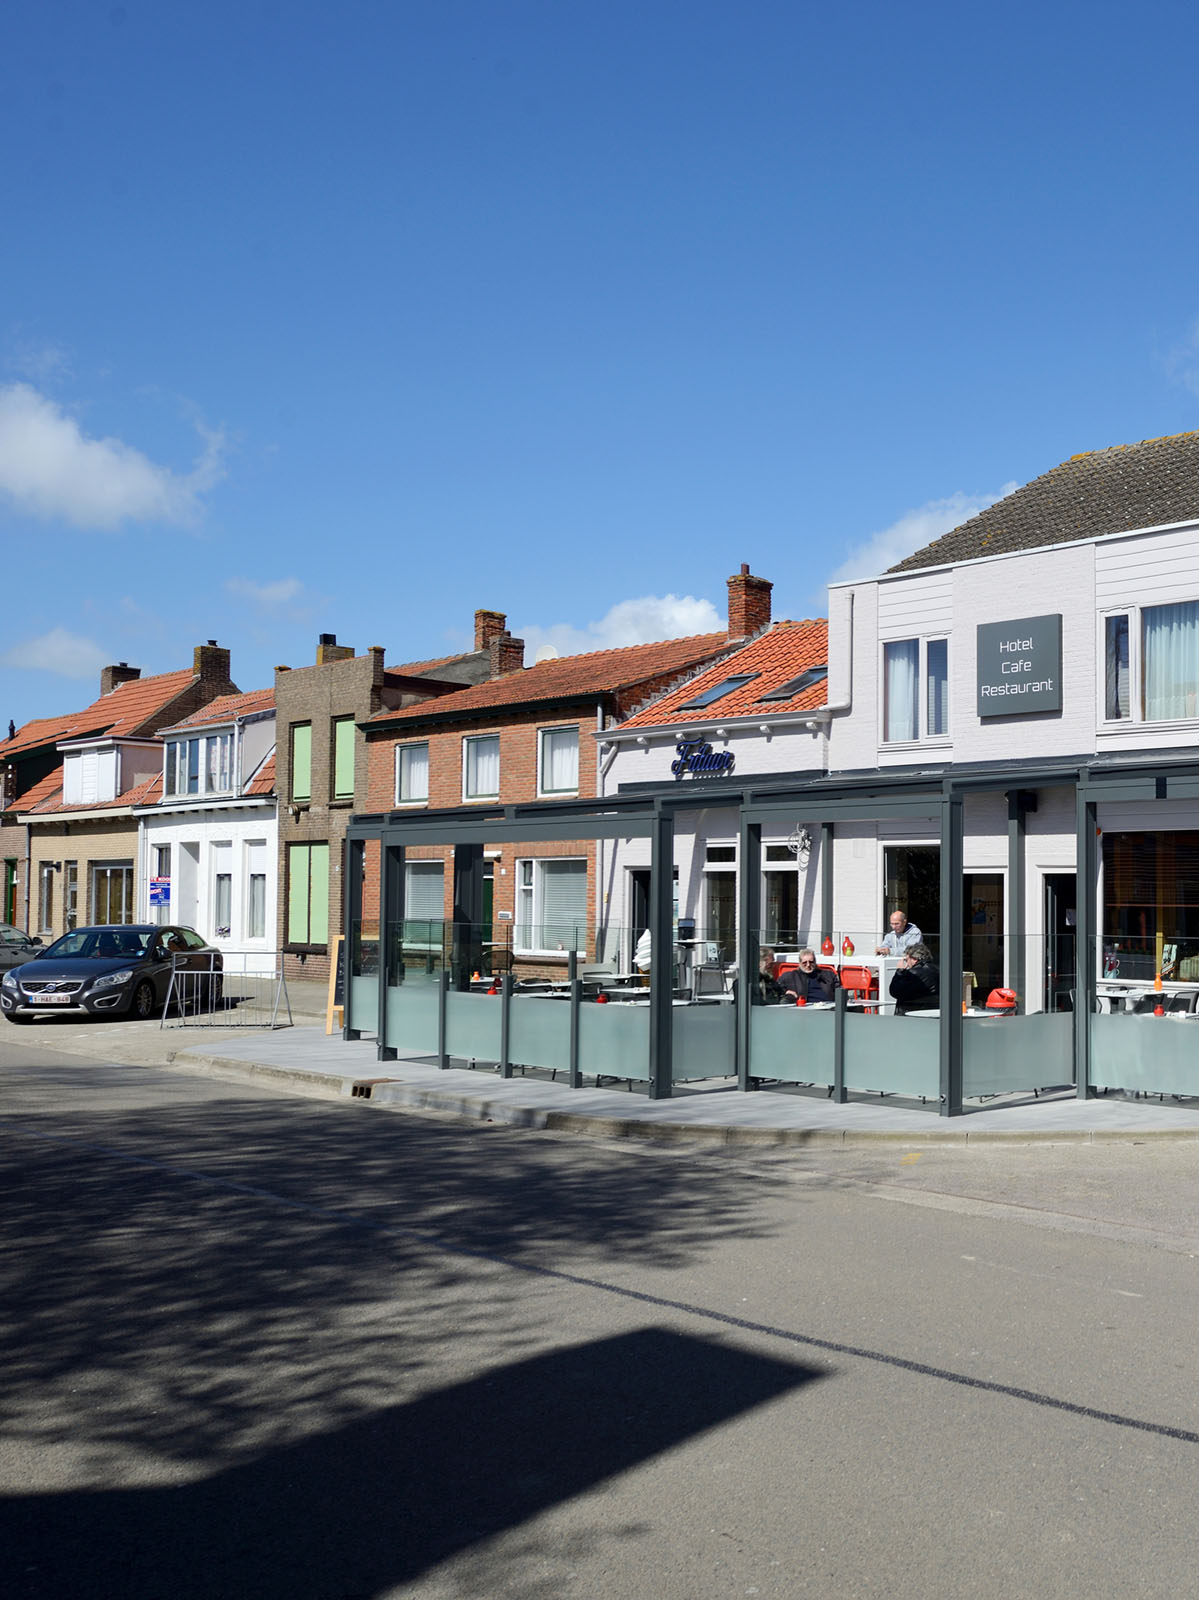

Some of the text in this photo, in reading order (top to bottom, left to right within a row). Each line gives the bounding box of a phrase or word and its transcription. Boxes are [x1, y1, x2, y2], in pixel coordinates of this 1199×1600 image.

[999, 637, 1034, 653] Hotel
[1001, 659, 1032, 674] Cafe
[981, 678, 1054, 697] Restaurant
